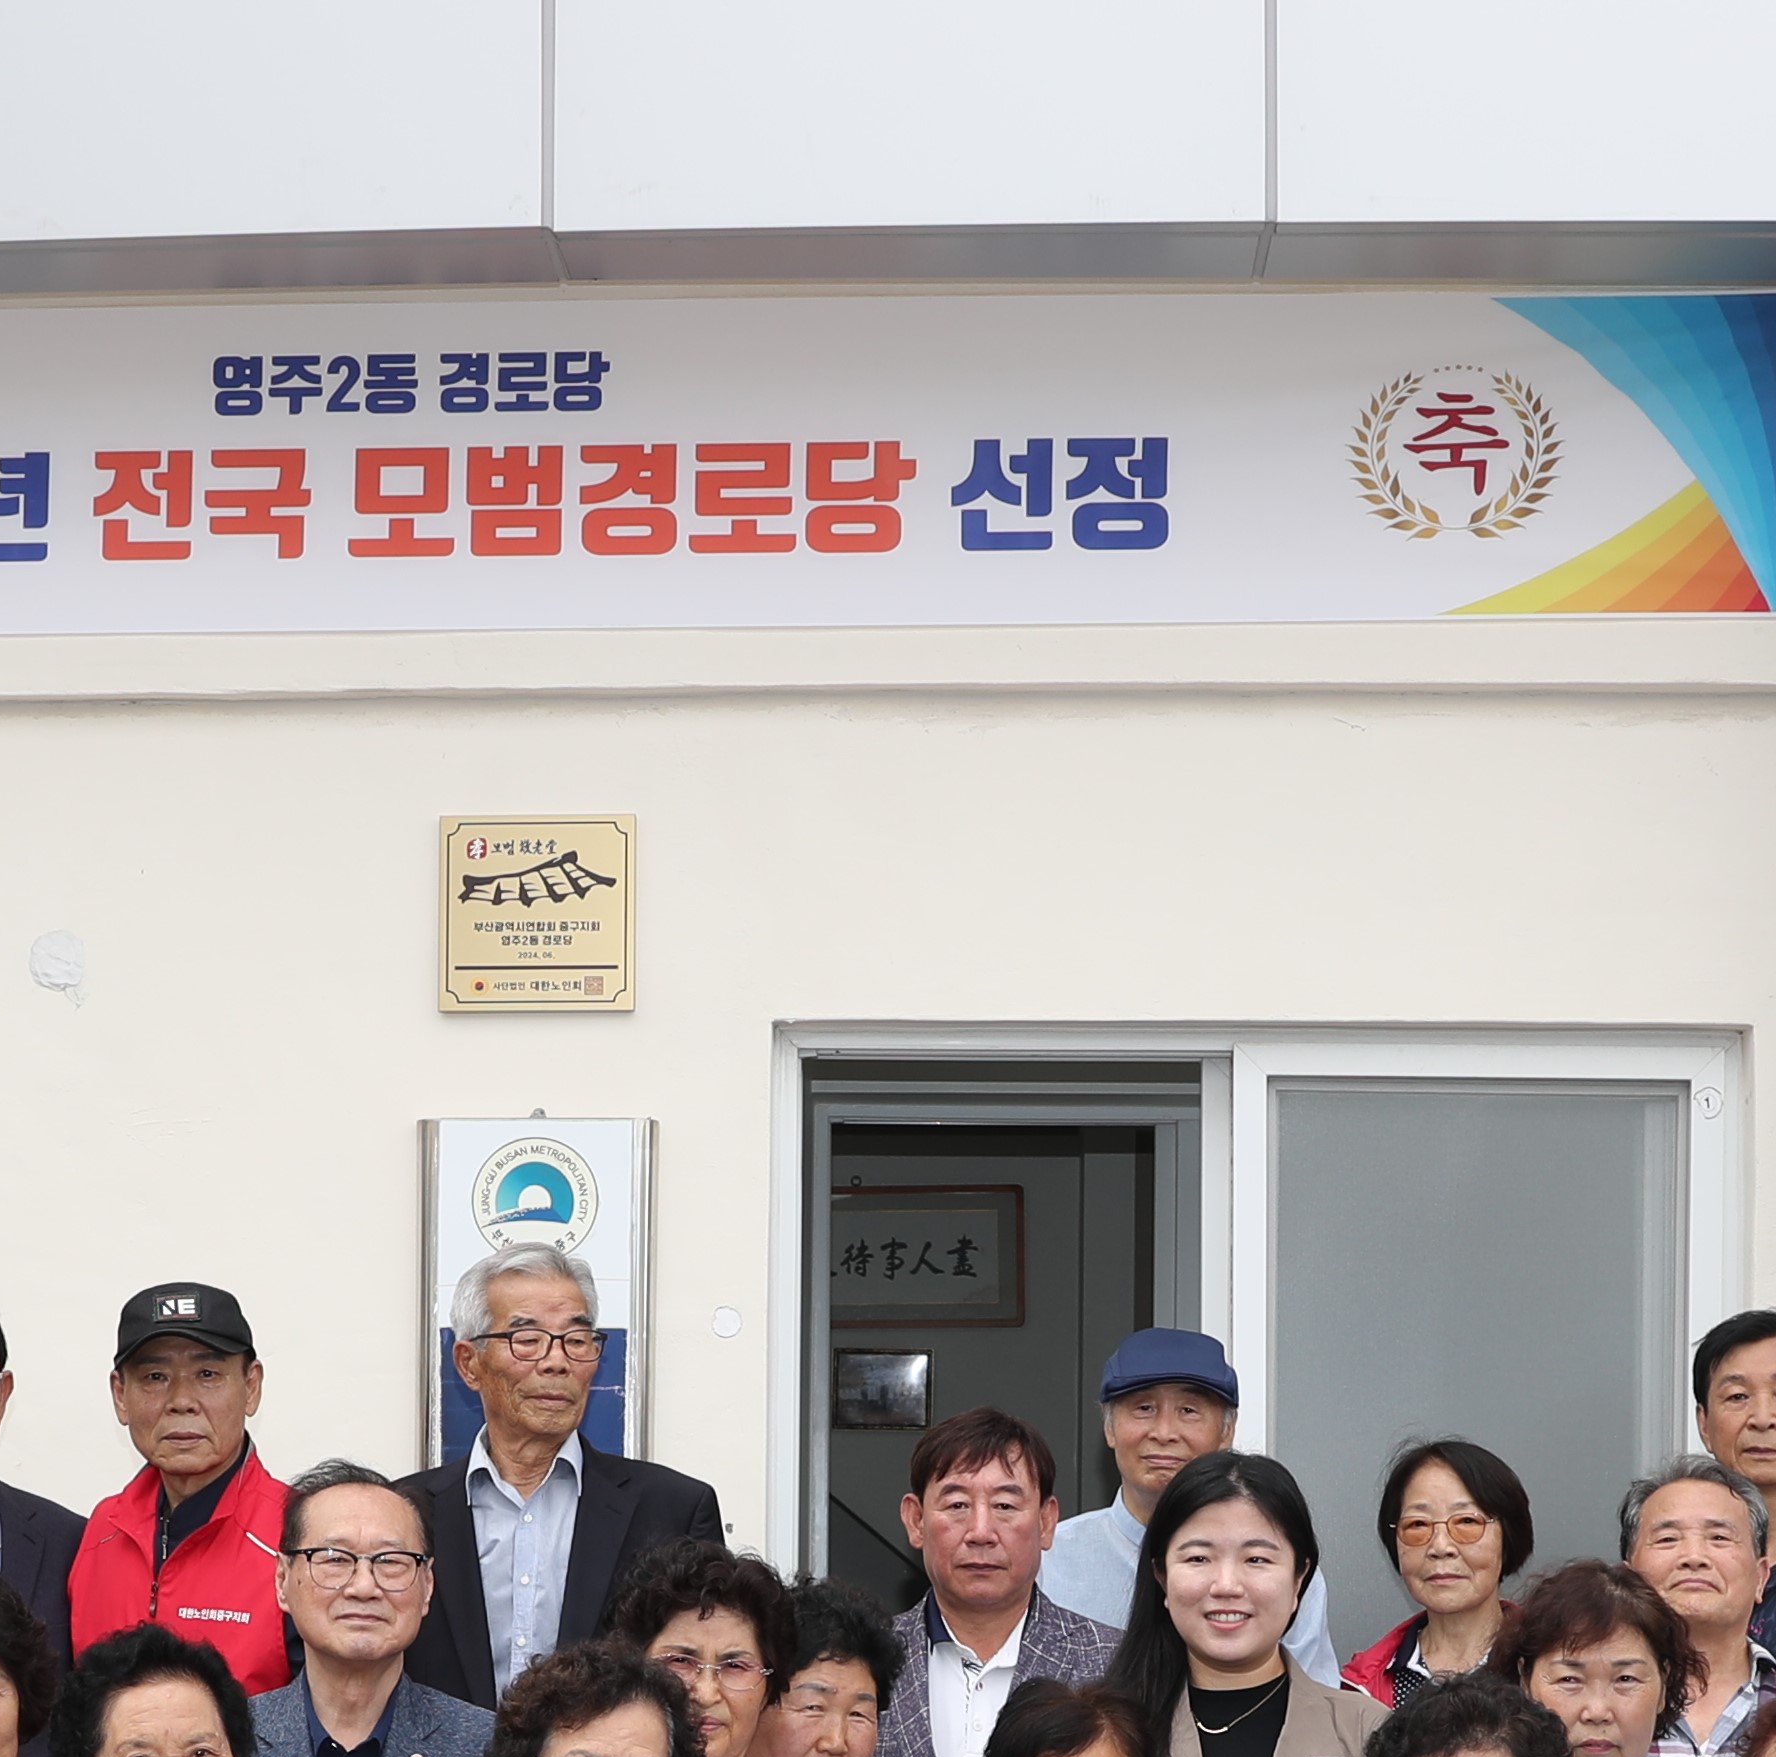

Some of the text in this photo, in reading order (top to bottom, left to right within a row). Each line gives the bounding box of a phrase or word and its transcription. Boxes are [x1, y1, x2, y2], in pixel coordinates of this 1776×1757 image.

[212, 351, 610, 415] 영주2동 경로당
[1402, 391, 1510, 496] 축
[91, 446, 314, 563] 전국
[346, 438, 920, 559] 모범경로당
[950, 435, 1171, 552] 선정
[490, 839, 515, 856] 모범
[473, 920, 601, 933] 부산광역시연합회 중구지회
[501, 935, 573, 946] 영주2동 경로당
[492, 981, 526, 991] 사단법인
[529, 980, 582, 992] 대한노인회
[481, 1145, 590, 1225] JUNG-GU BUSAN METROPOLITAN CITY
[177, 1606, 252, 1625] 대한노인회중구지회
